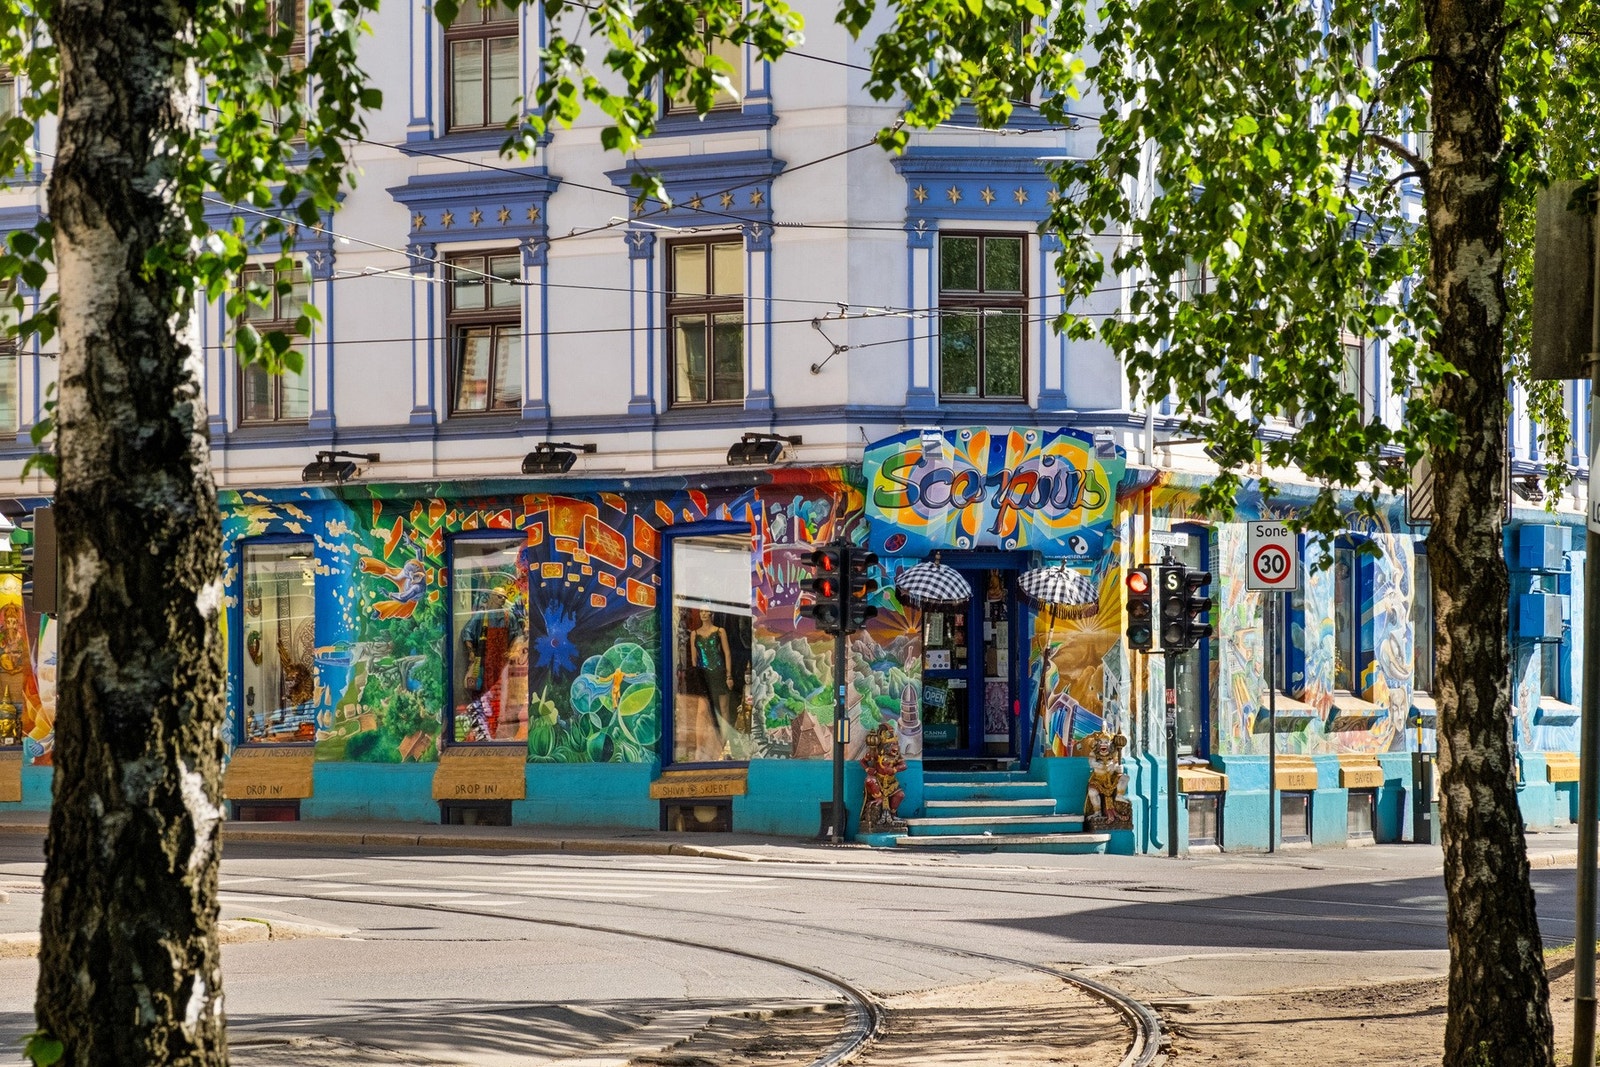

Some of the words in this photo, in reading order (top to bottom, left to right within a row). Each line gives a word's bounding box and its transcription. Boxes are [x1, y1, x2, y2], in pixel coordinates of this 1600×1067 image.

[873, 449, 1107, 535] Scorpius
[1256, 525, 1288, 537] Sone
[1261, 554, 1284, 574] 30
[1167, 574, 1178, 590] S
[925, 691, 945, 703] OPEN
[246, 785, 267, 795] DROP
[270, 785, 283, 794] IN!
[455, 784, 480, 794] DROP
[484, 784, 498, 794] IN!
[662, 786, 684, 796] SHIVA
[700, 784, 729, 794] SKJERF
